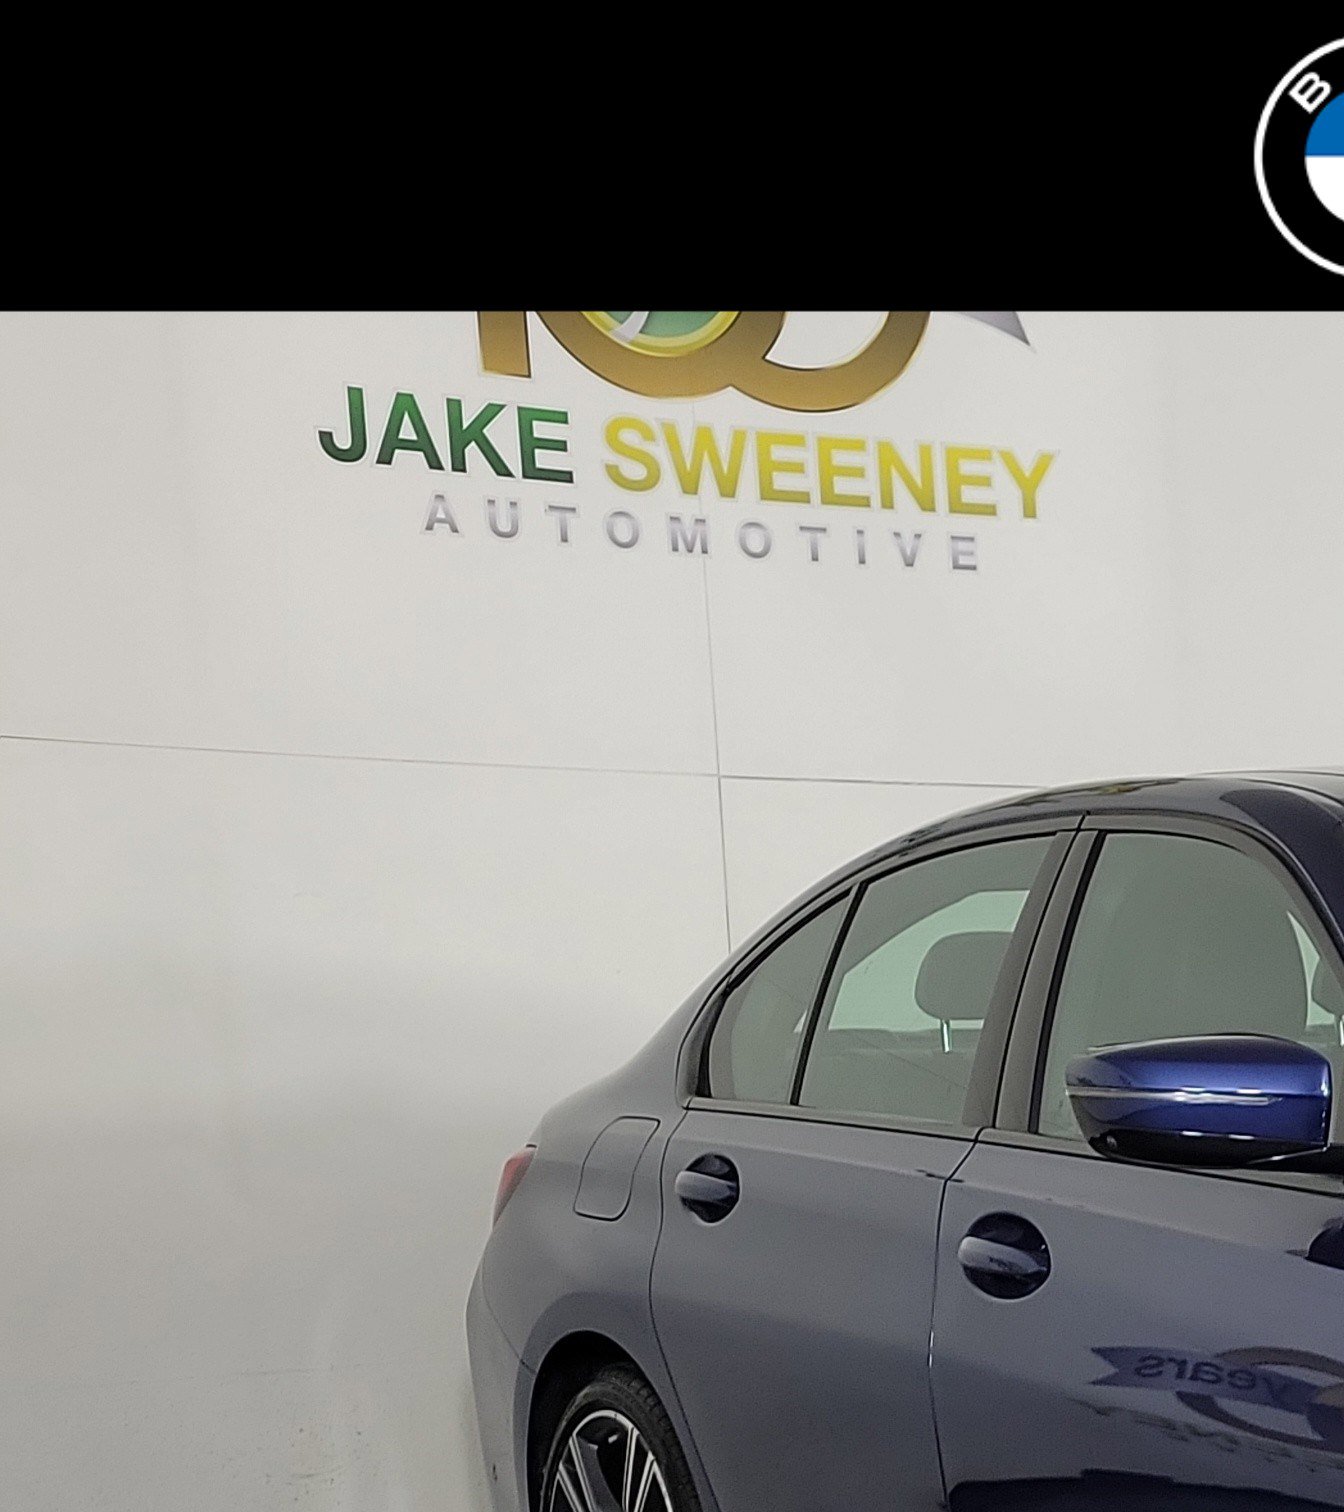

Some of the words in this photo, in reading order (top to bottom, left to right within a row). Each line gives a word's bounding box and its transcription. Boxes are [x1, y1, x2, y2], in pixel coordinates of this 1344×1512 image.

[317, 385, 575, 484] JAKE
[603, 415, 1056, 519] SWEENEY
[423, 493, 979, 571] AUTOMOTIVE
